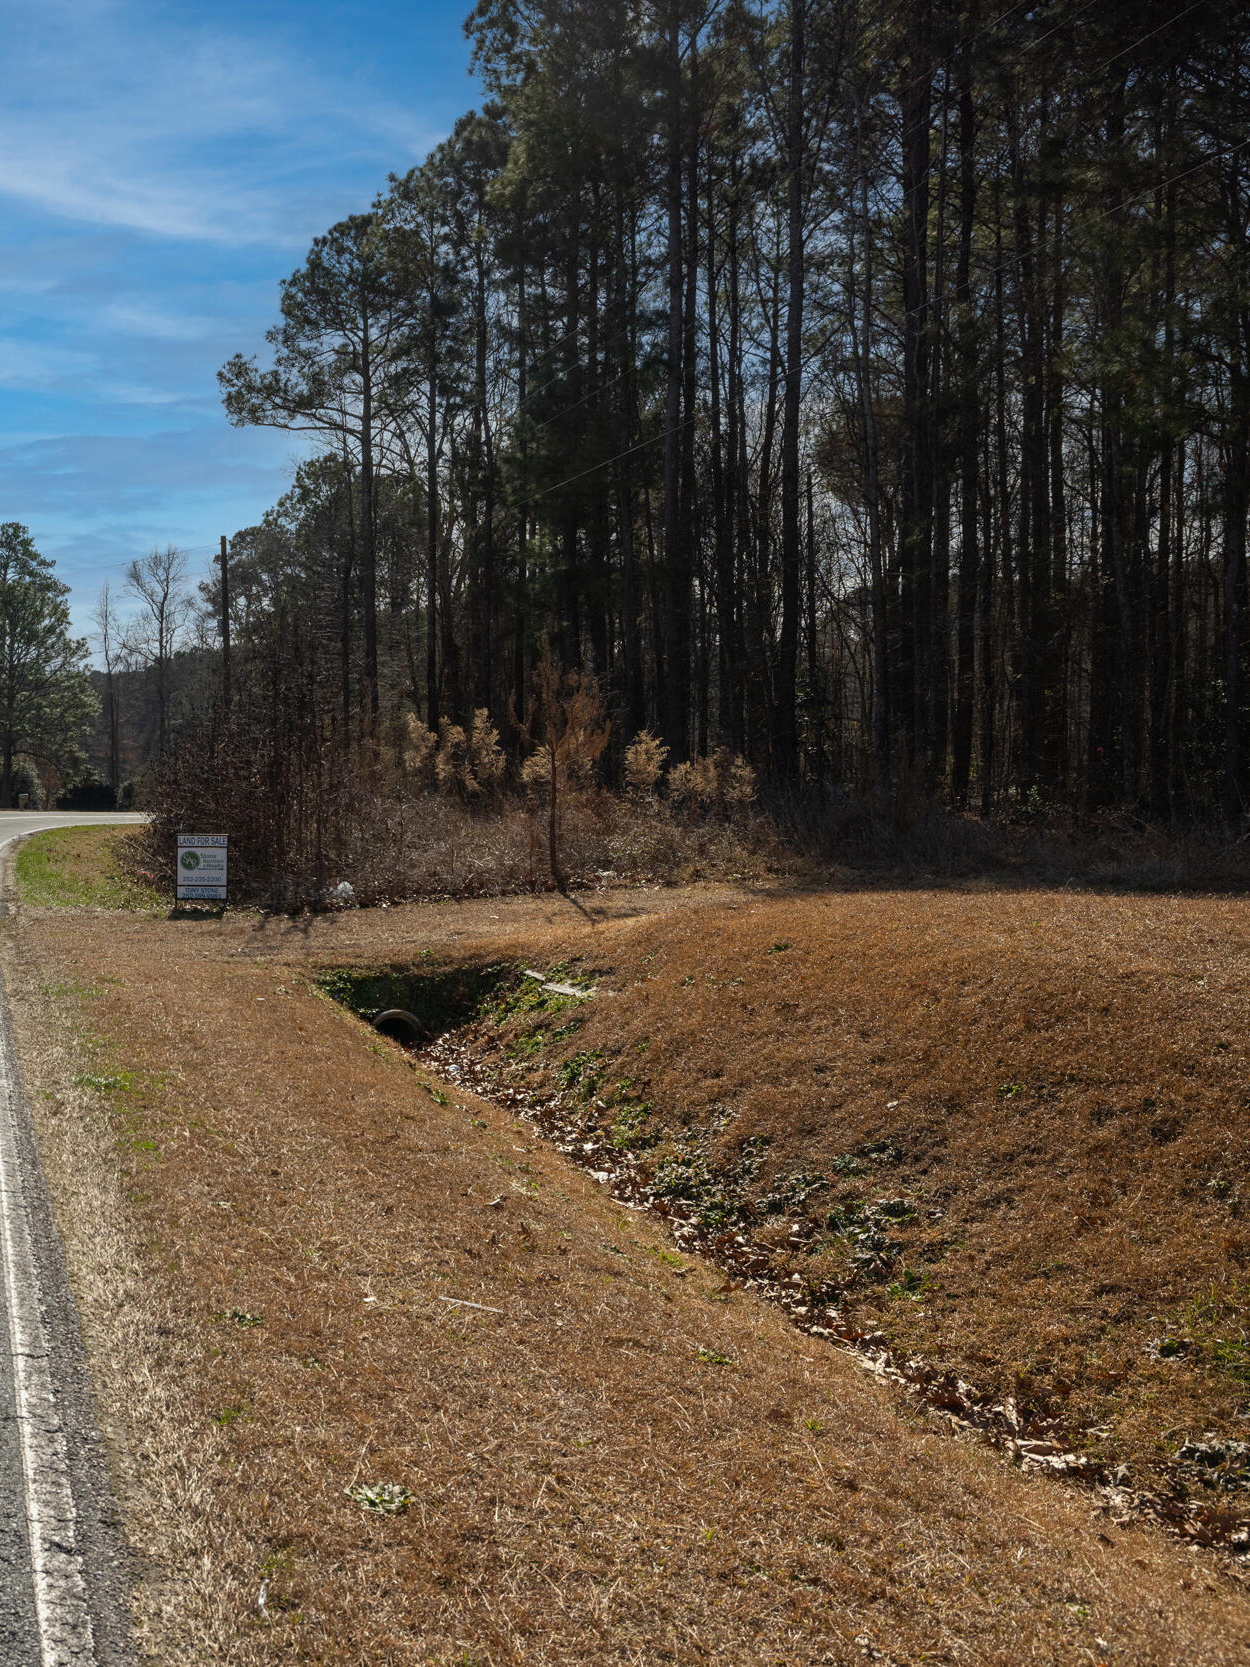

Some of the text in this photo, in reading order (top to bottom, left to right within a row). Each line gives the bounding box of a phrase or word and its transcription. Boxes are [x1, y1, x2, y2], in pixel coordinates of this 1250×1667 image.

[179, 837, 226, 845] LAND FOR SALE
